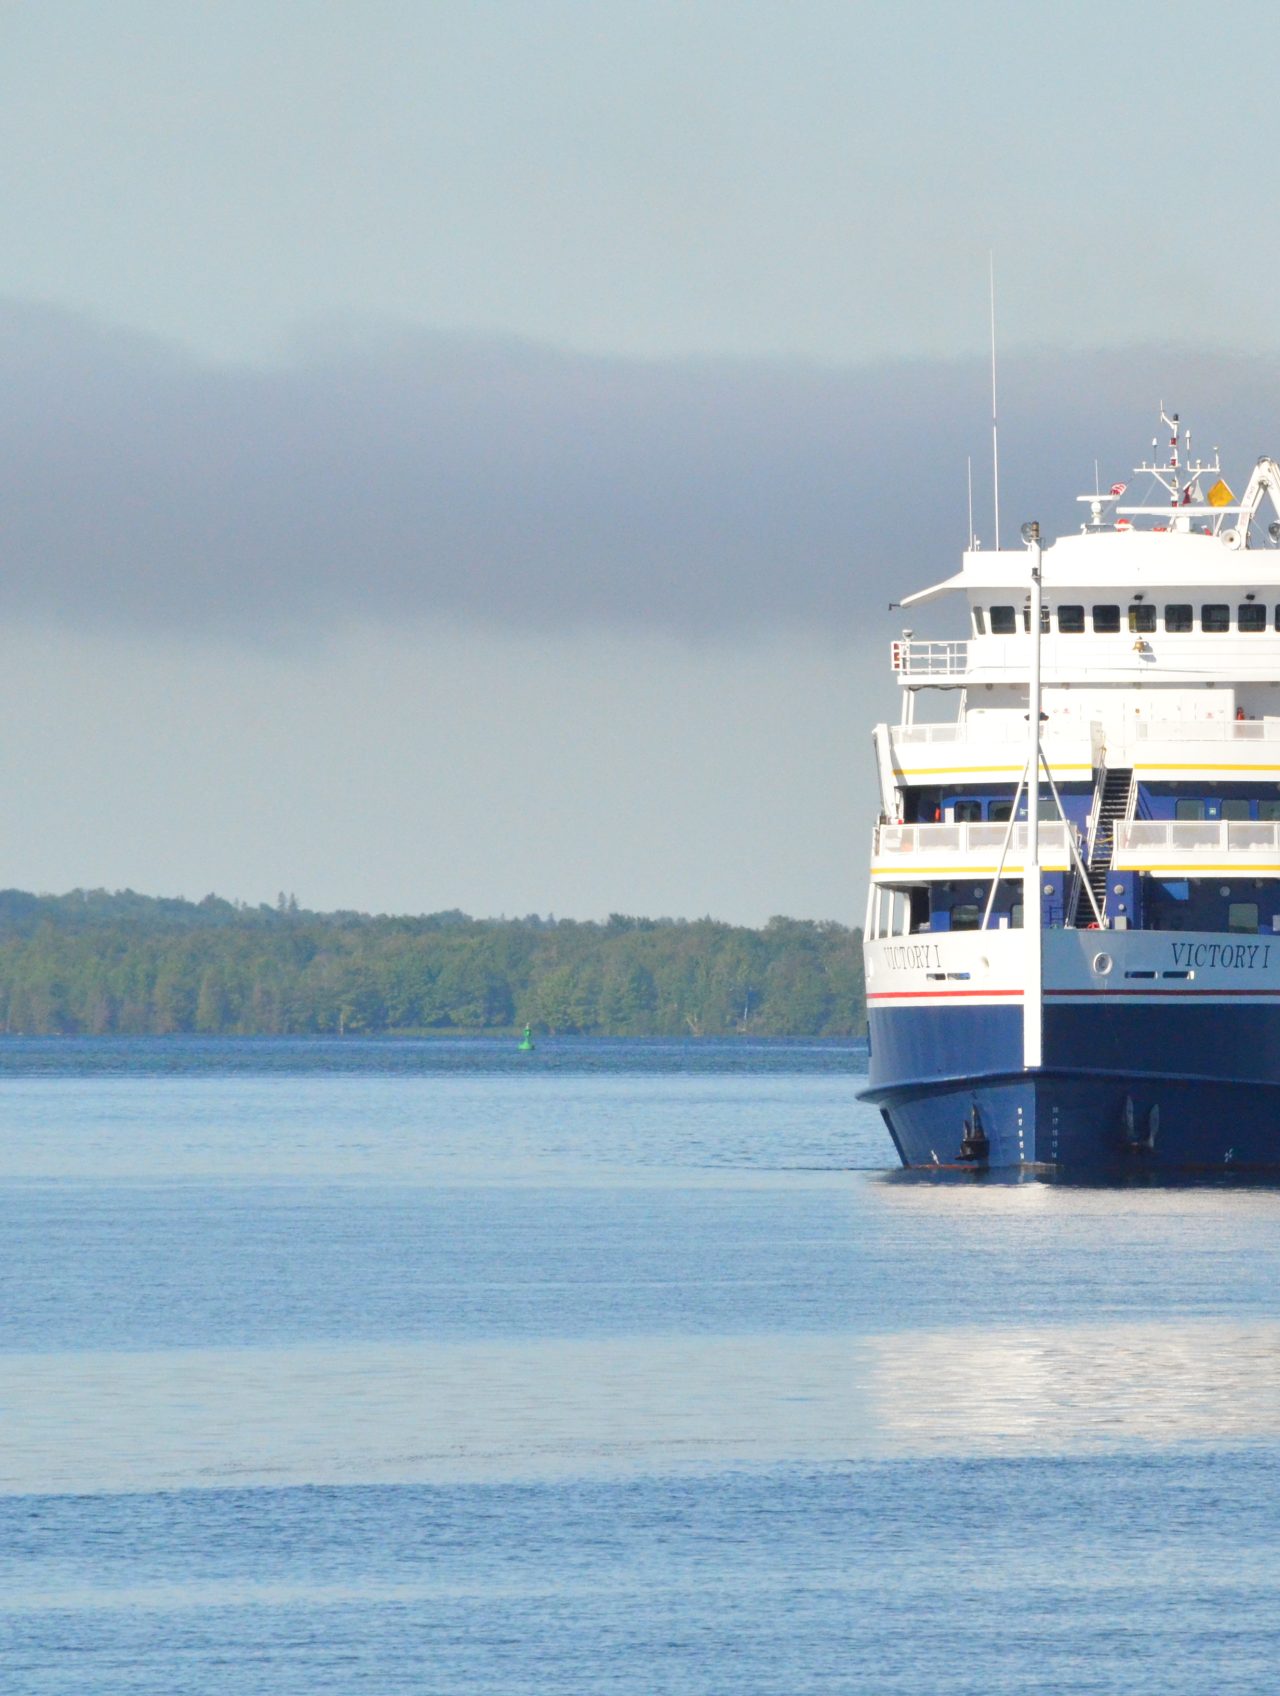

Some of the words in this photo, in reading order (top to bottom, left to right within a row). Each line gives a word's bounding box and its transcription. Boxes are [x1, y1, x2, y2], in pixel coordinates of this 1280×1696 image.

[883, 945, 930, 969] VICTORY
[933, 945, 942, 968] I
[1171, 943, 1260, 969] VICTORY
[1262, 945, 1271, 968] I
